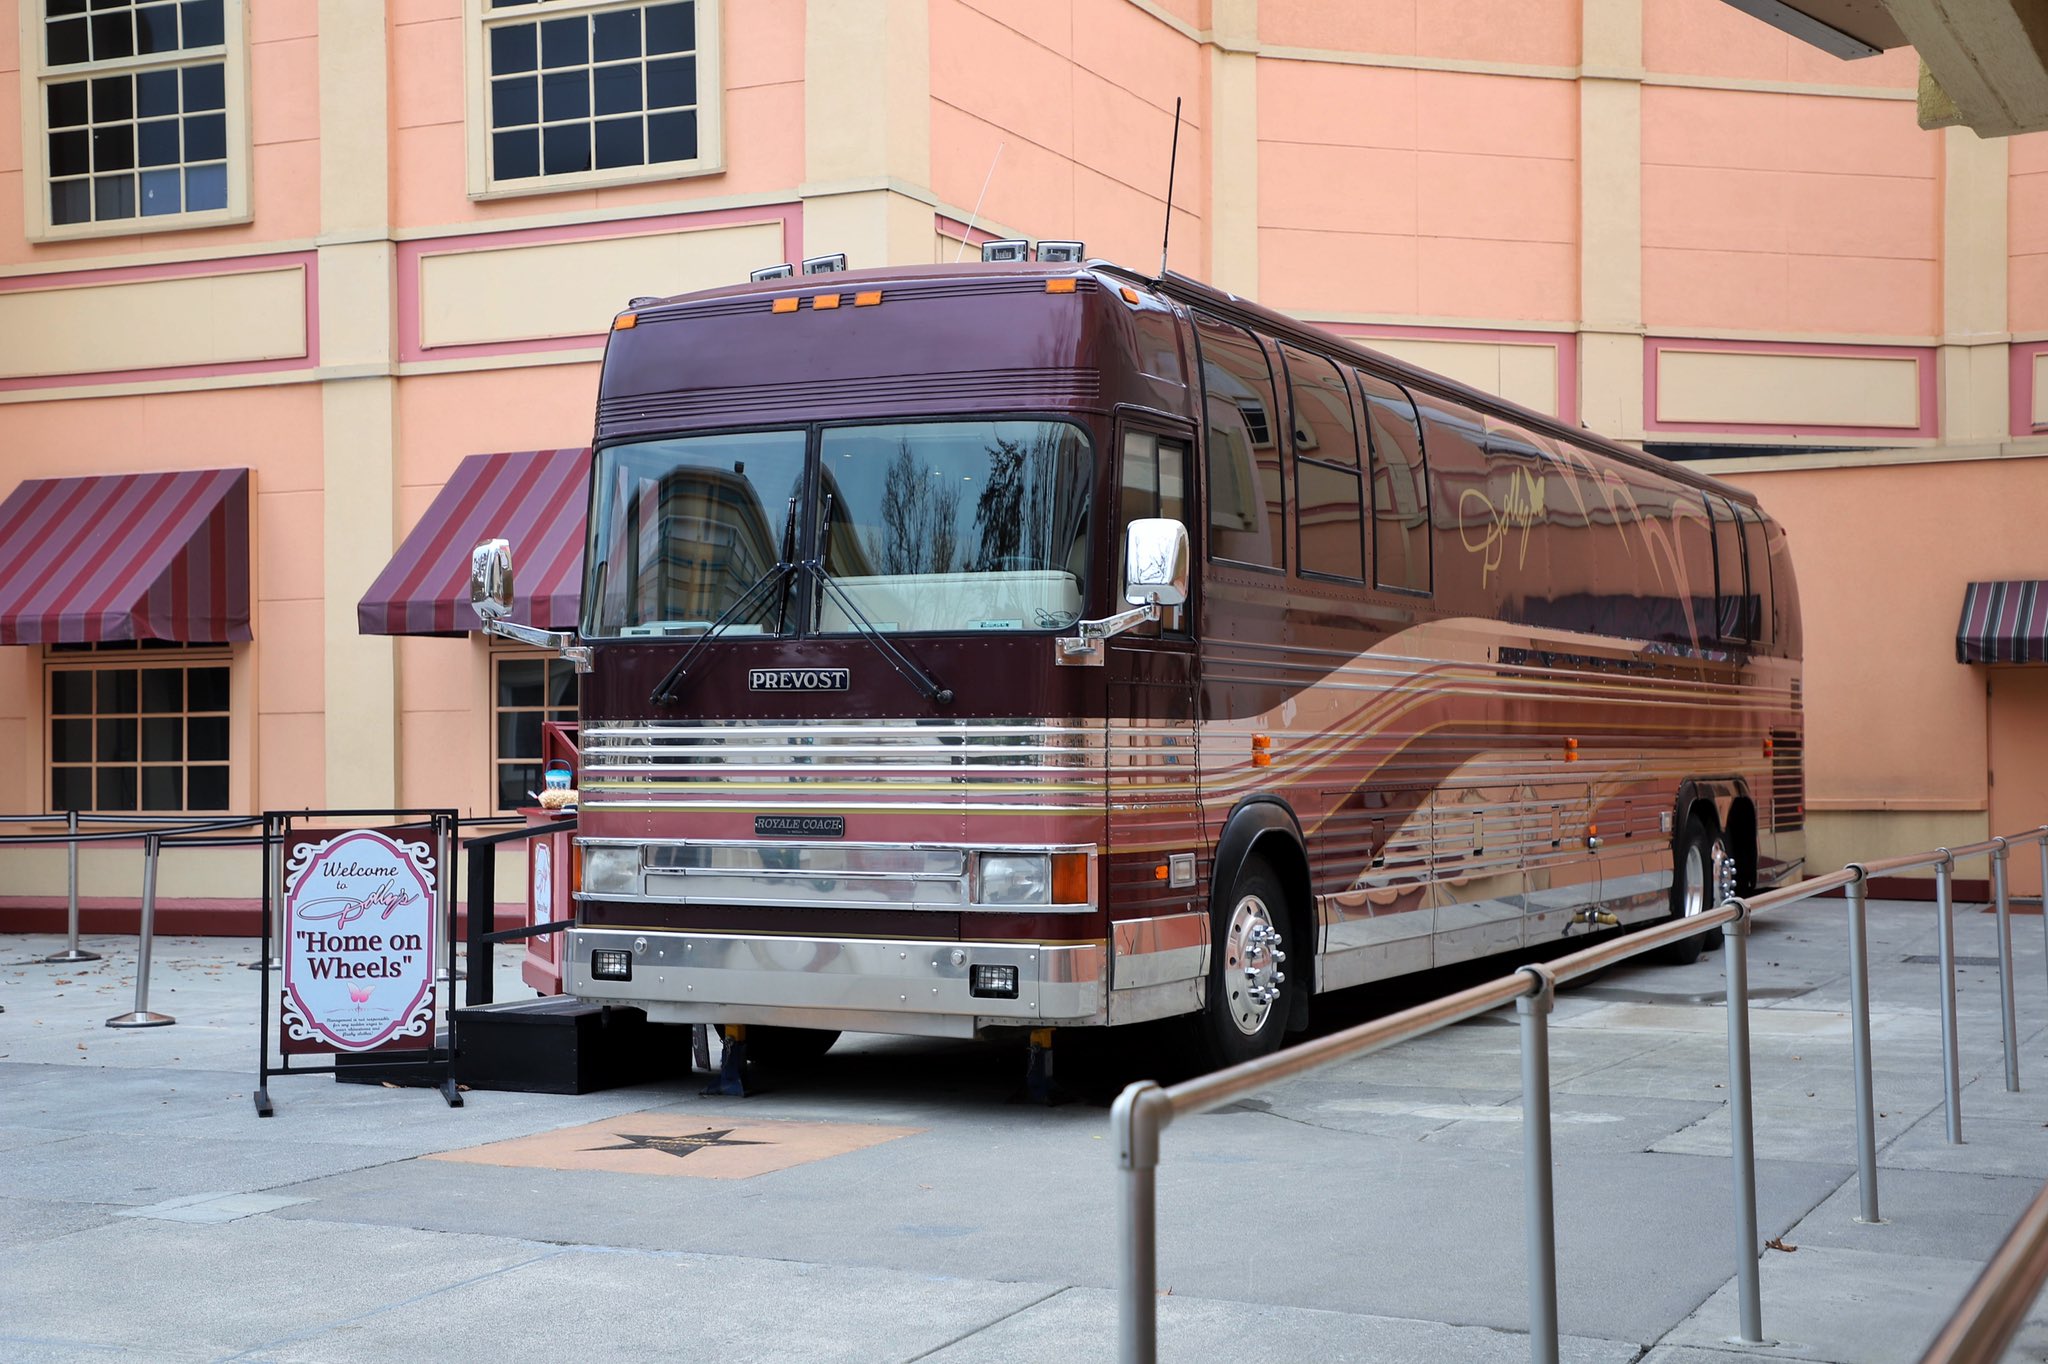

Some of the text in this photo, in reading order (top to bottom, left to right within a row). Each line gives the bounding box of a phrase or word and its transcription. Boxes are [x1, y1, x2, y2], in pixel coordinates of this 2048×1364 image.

[752, 672, 845, 689] PREVOST
[757, 818, 840, 830] ROYALE COACH
[323, 861, 399, 877] Welcome
[336, 880, 348, 890] to
[297, 879, 419, 930] Dolly's
[296, 930, 423, 953] "Home on
[307, 955, 413, 980] Wheels"
